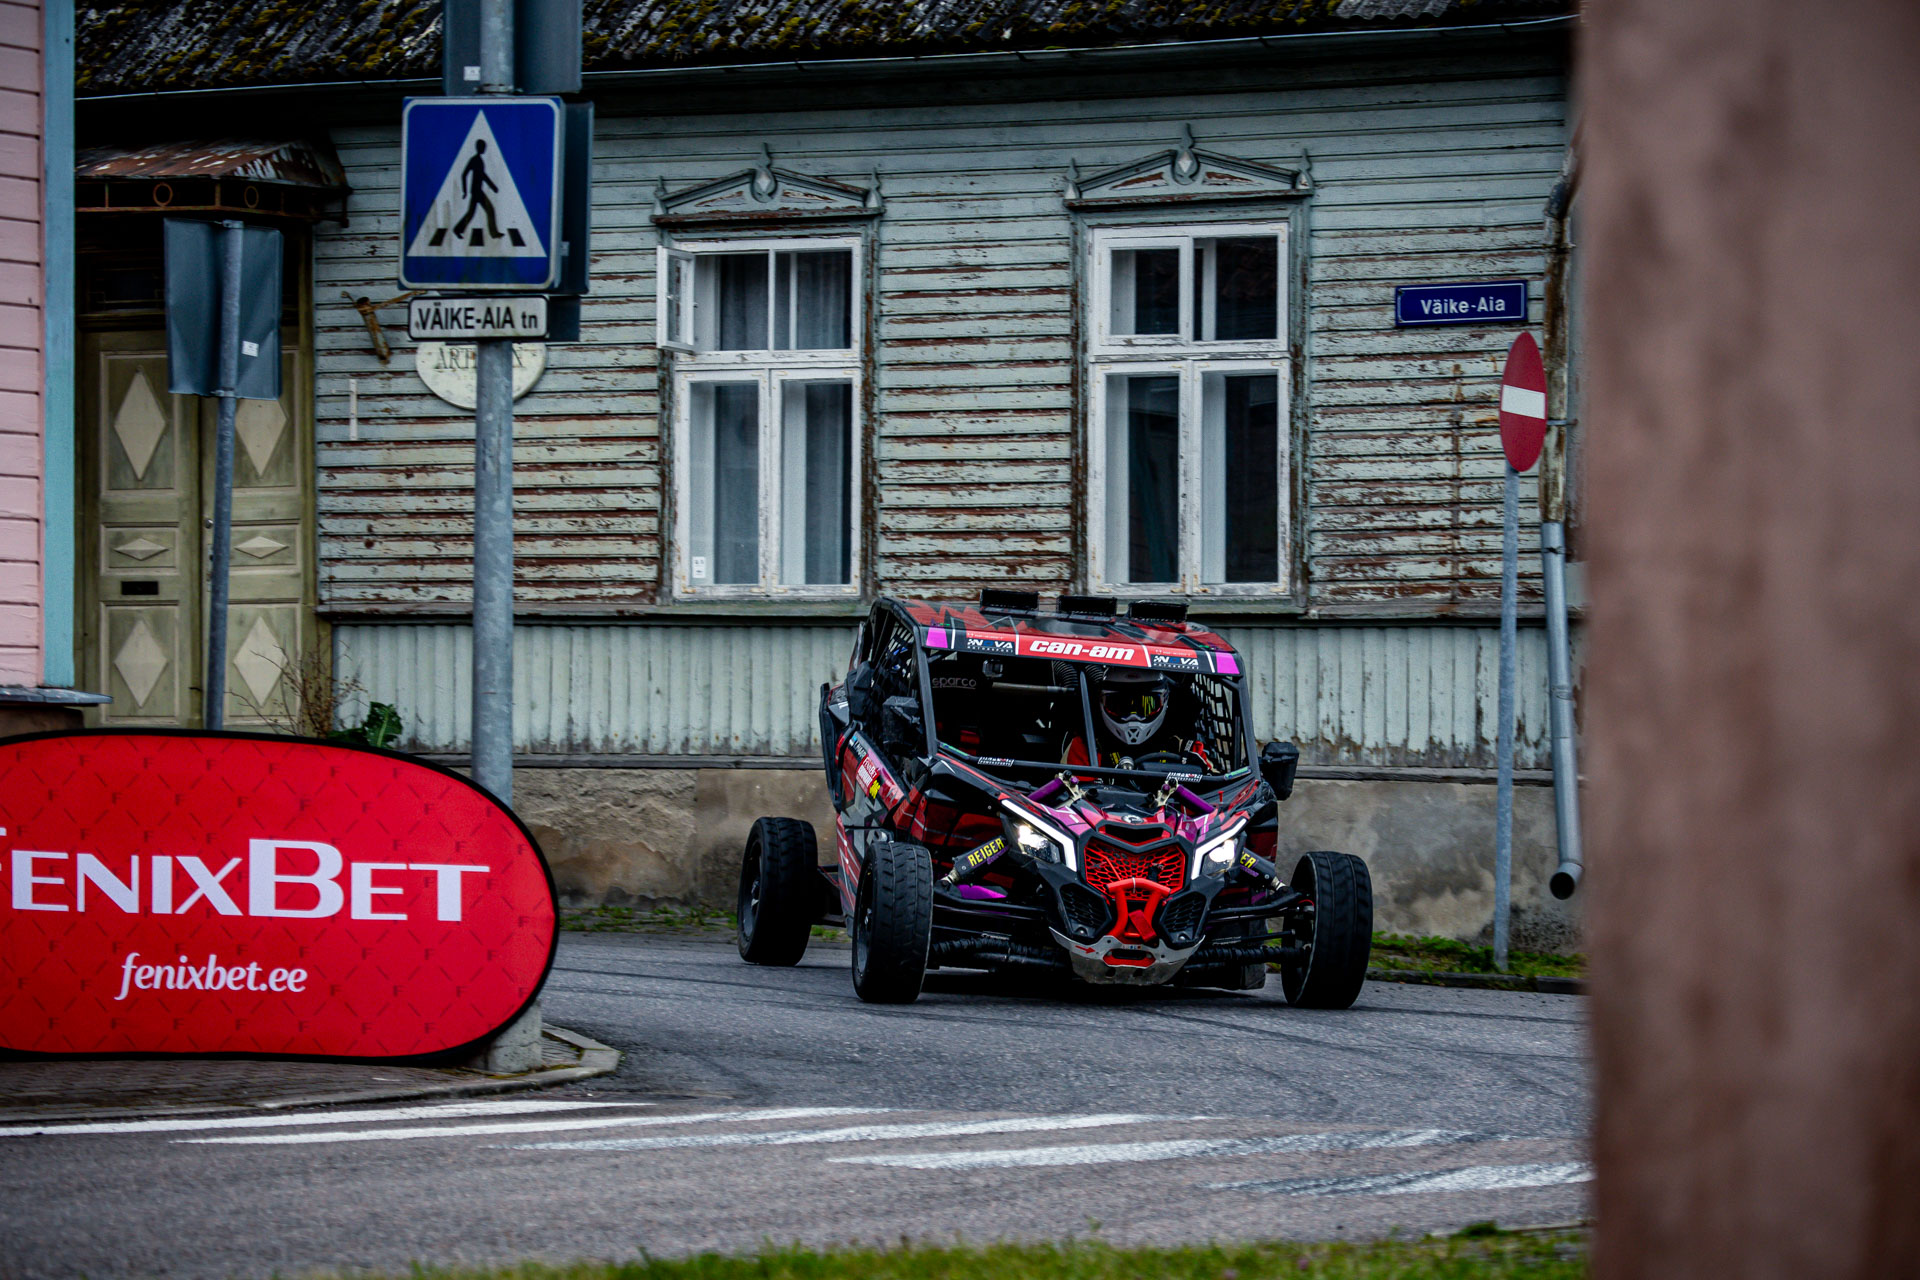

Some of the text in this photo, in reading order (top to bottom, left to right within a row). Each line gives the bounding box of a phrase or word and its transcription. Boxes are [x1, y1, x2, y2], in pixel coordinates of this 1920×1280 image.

[418, 301, 538, 330] VÄIKE-AIA tn
[1420, 296, 1506, 315] Väike-Aia
[1029, 639, 1135, 661] can-am
[931, 677, 977, 690] sparco
[967, 837, 1005, 867] REIGER
[0, 827, 491, 922] ENIXBET
[114, 952, 308, 1001] fenixbet.ee
